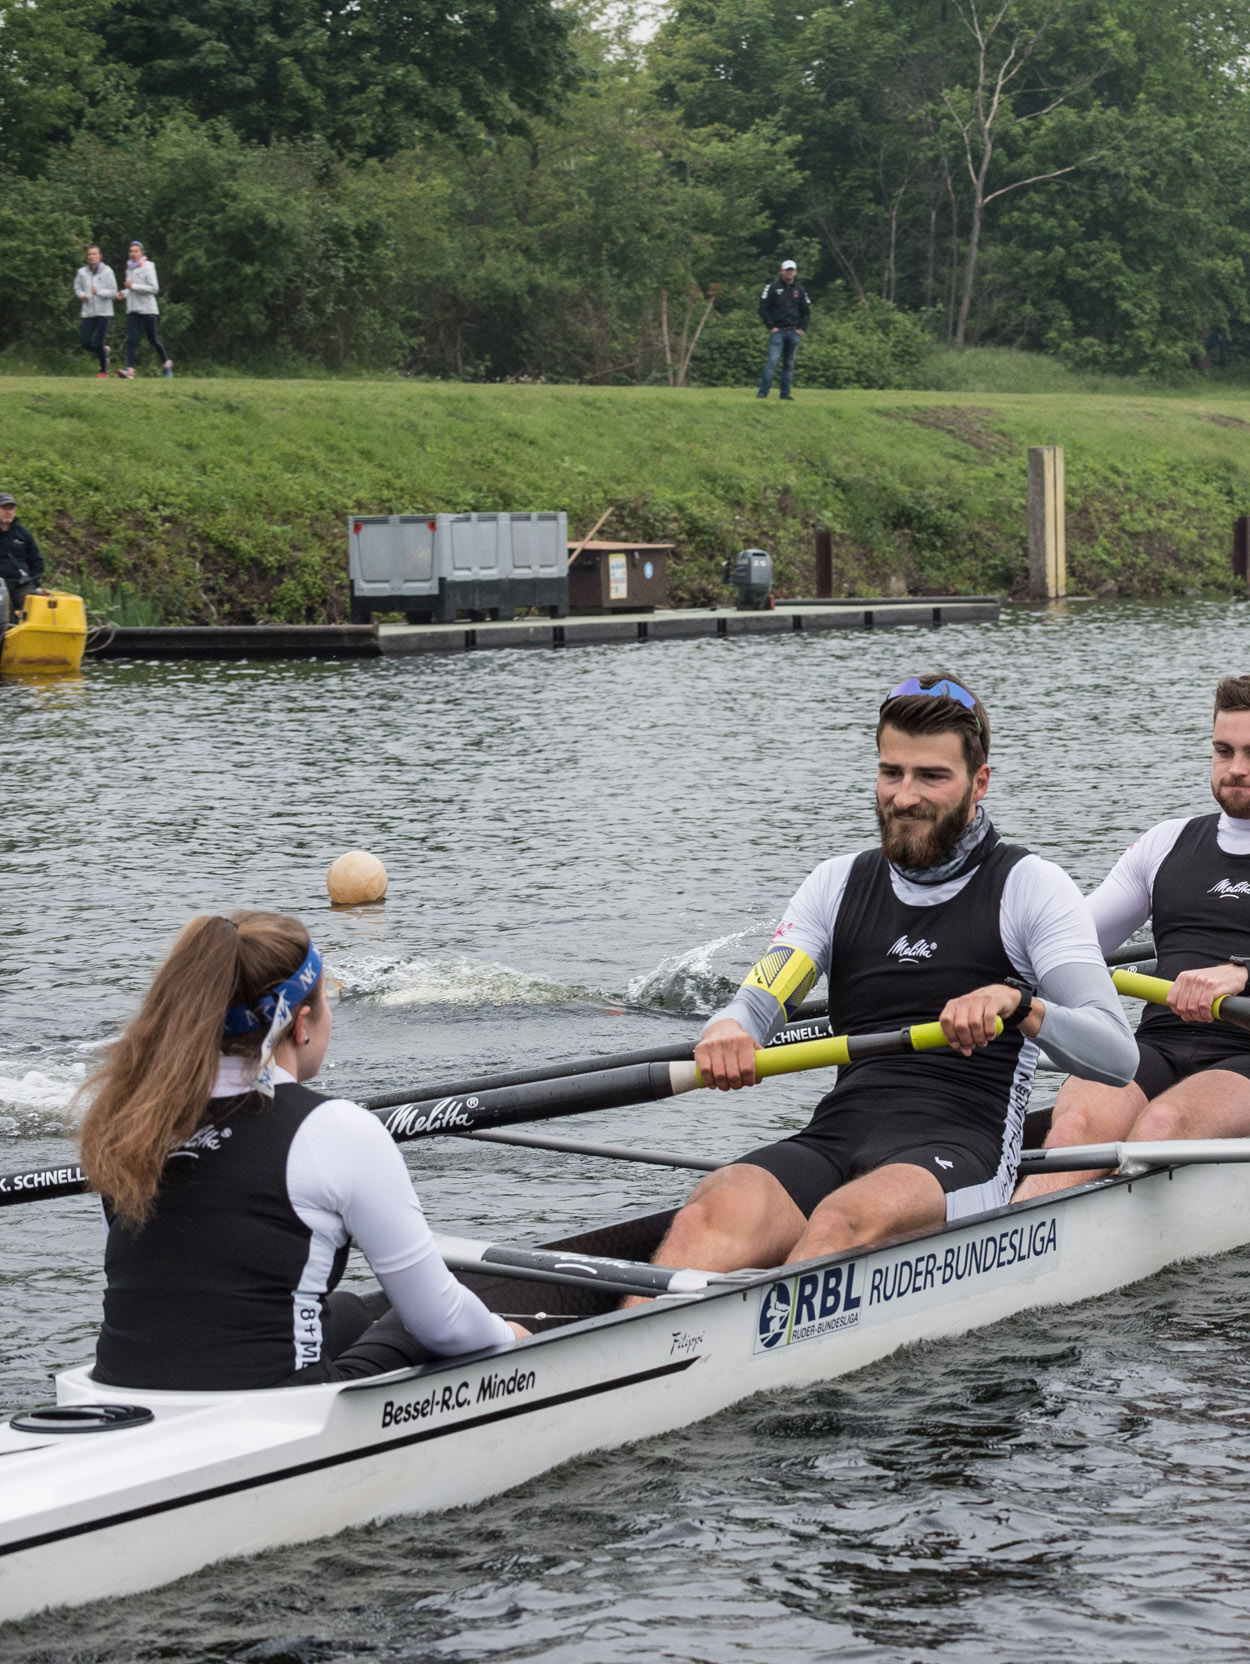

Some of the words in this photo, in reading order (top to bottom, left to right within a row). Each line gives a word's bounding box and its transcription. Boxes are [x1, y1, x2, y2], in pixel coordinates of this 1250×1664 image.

[869, 1218, 1058, 1306] RUDER-BUNDESLIGA
[794, 1263, 862, 1326] RBL
[670, 1330, 705, 1355] Filippi
[792, 1312, 859, 1341] RUDER-BUNDESLIGA
[381, 1381, 471, 1428] Bessel-R.C.
[476, 1368, 535, 1404] Minden
